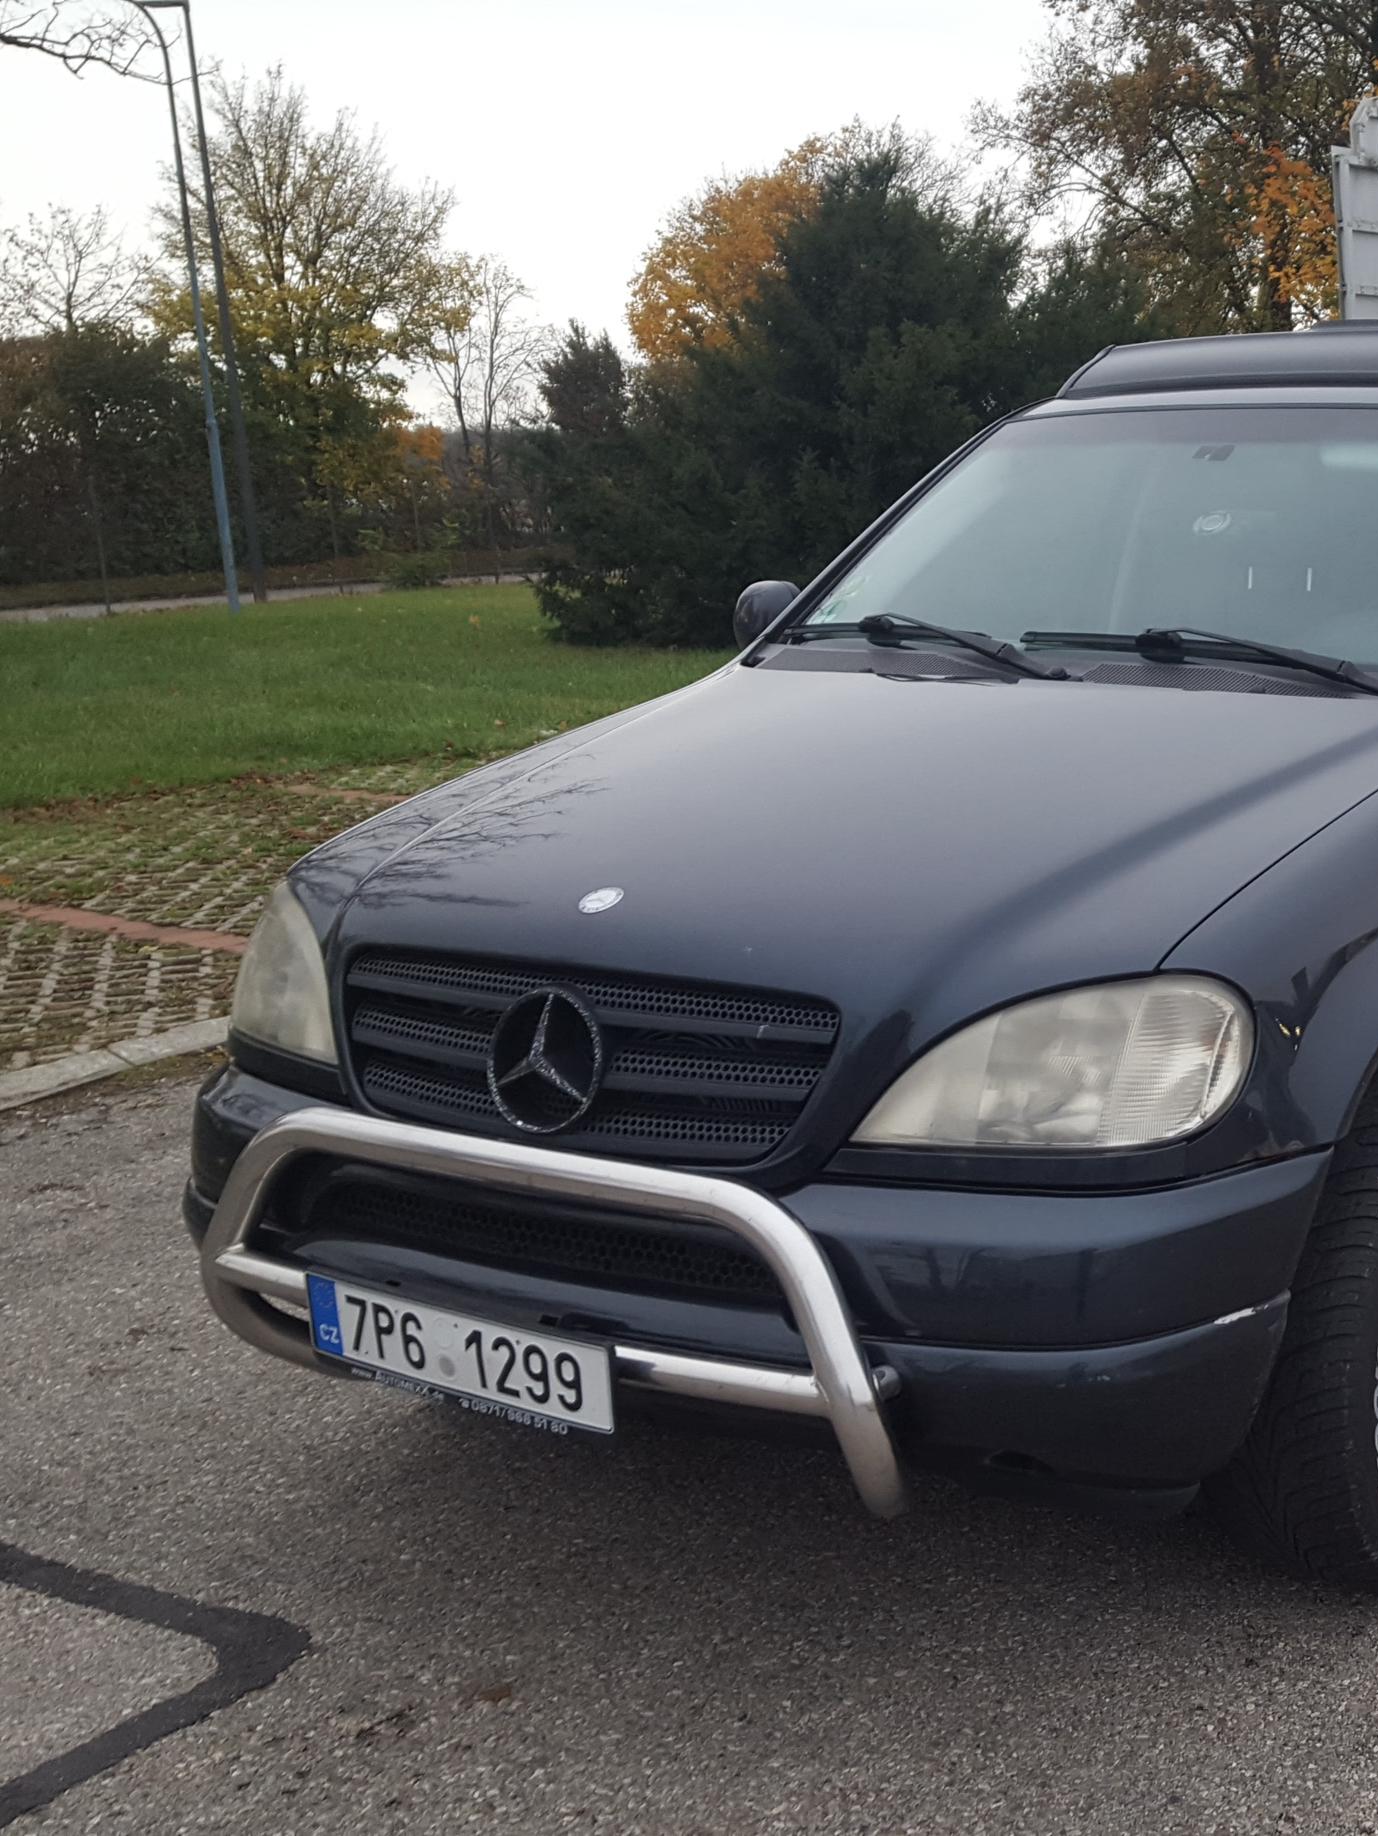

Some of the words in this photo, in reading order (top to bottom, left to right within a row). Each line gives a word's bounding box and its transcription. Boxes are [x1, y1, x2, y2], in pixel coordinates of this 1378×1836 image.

[319, 1323, 341, 1344] CZ
[344, 1295, 426, 1370] 7P6
[464, 1329, 583, 1412] 1299
